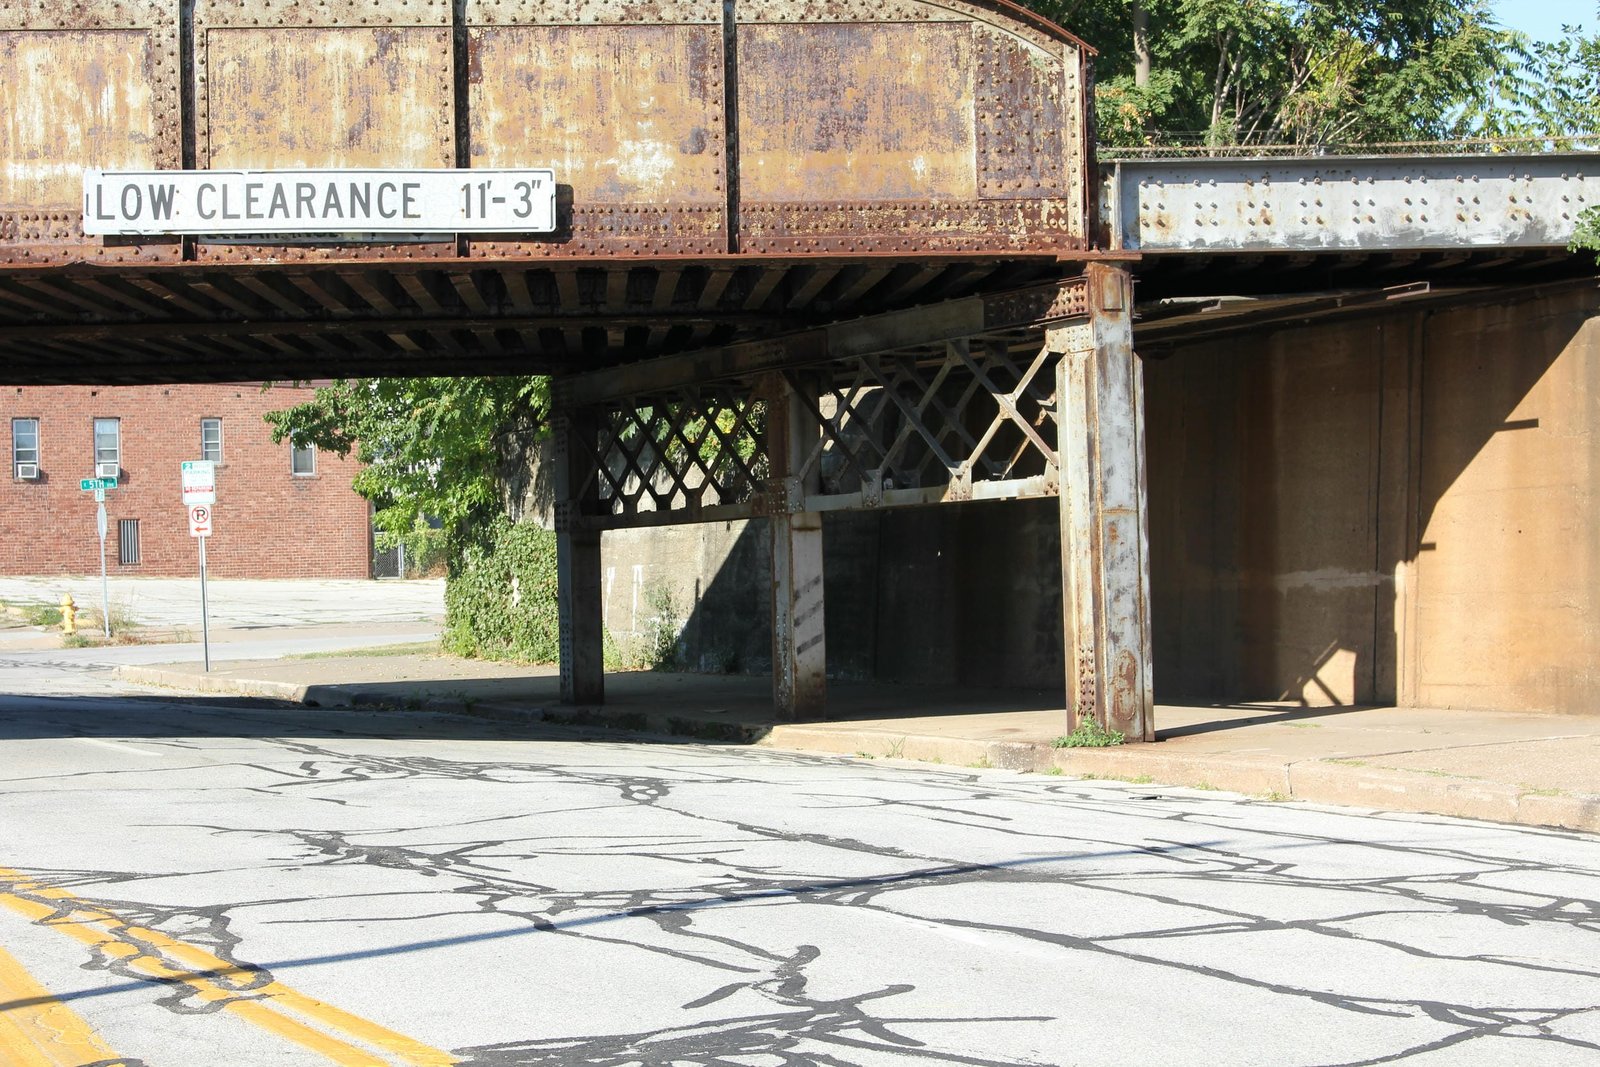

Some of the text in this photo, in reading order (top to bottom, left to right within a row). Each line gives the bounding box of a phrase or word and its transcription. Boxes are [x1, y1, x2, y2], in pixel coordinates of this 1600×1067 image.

[97, 183, 175, 221] LOW
[197, 181, 421, 220] CLEARANCE
[89, 479, 104, 489] 5TH
